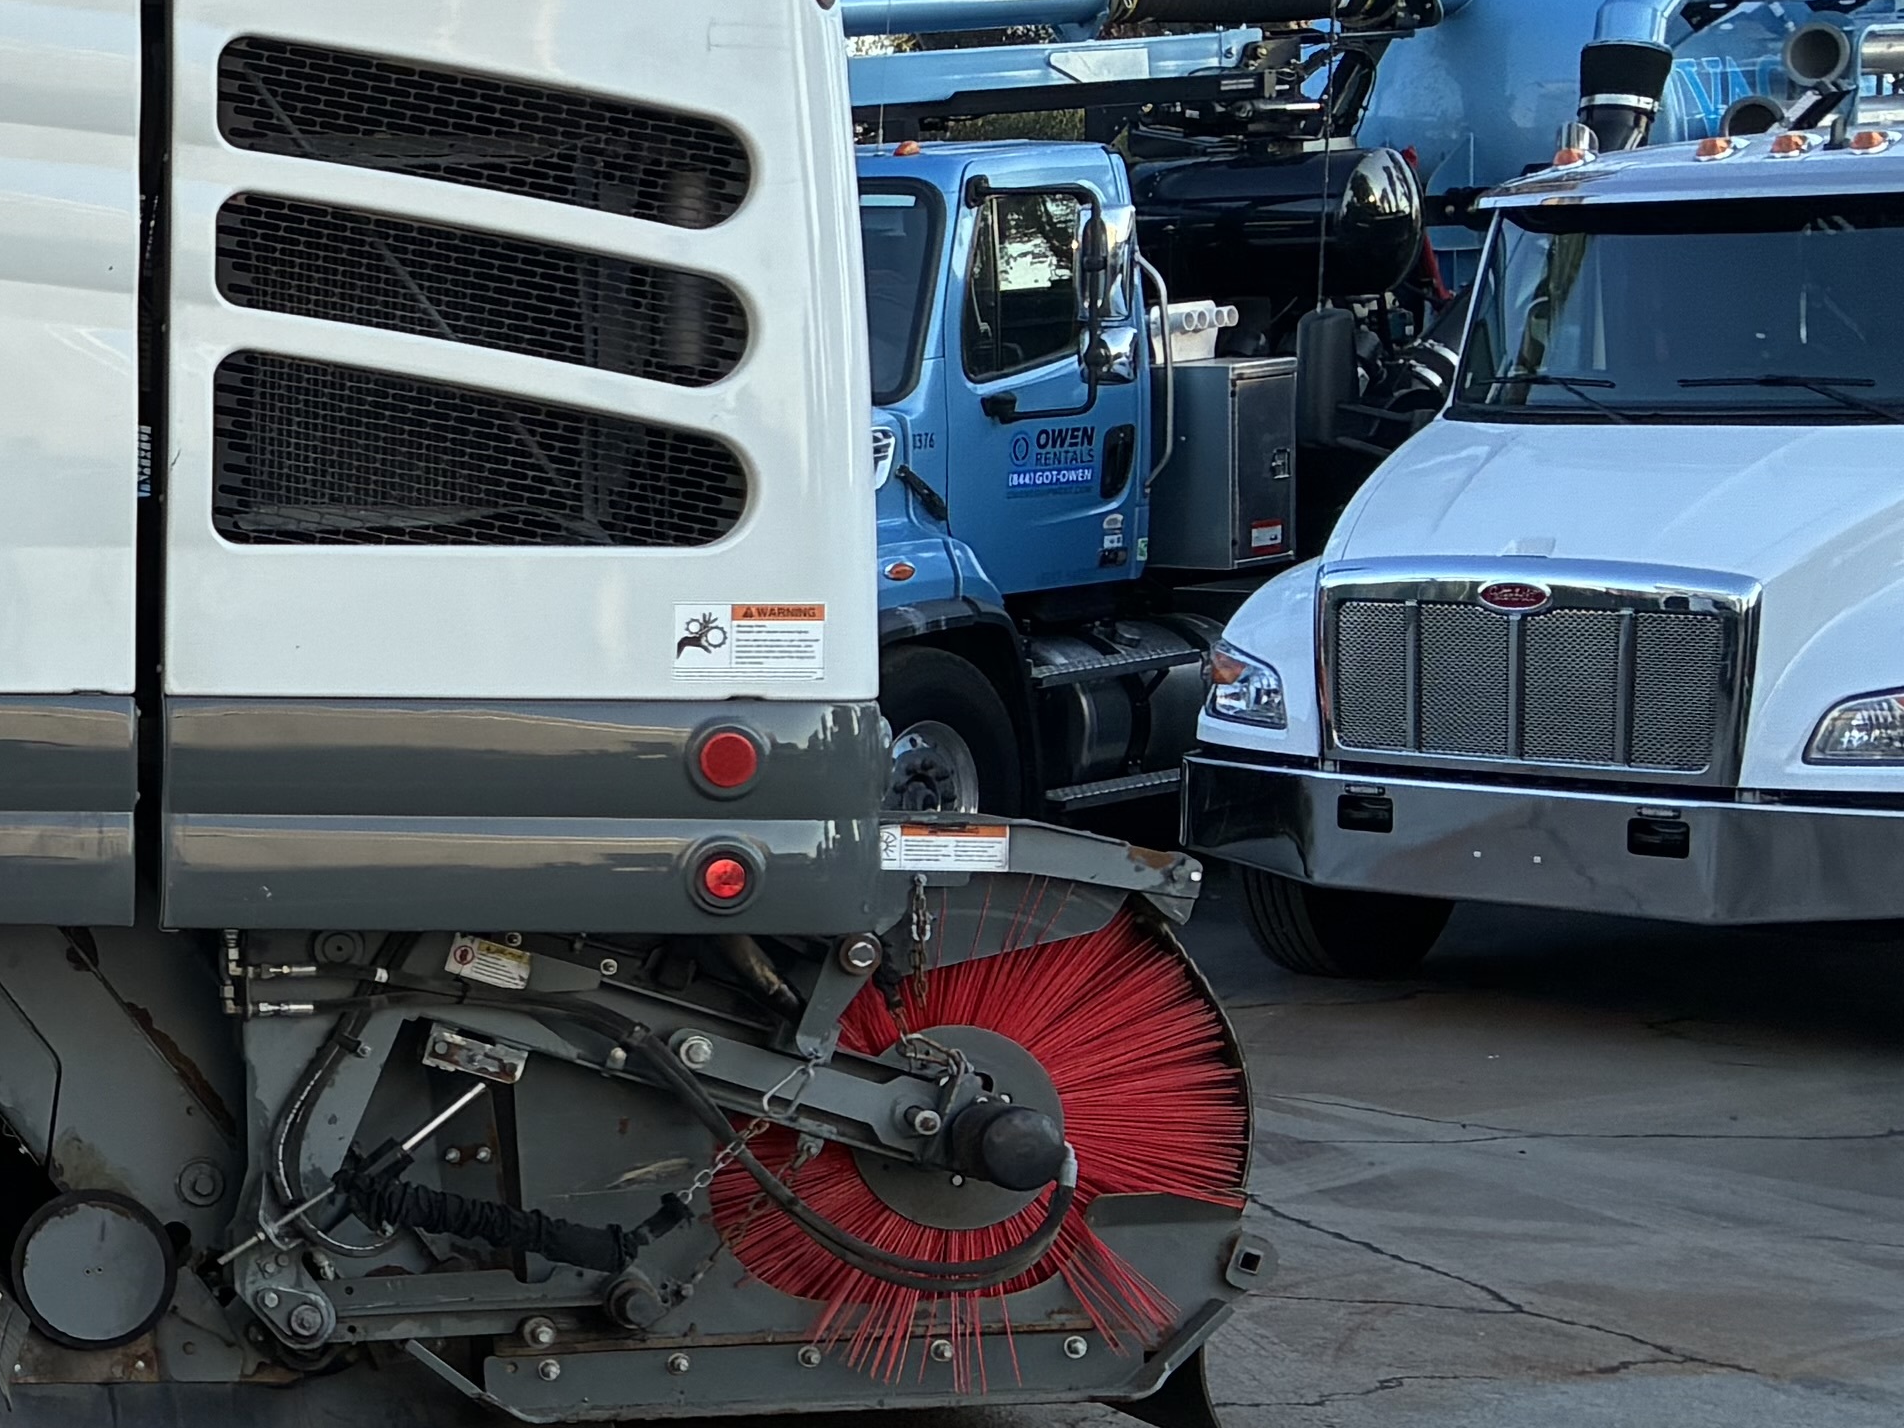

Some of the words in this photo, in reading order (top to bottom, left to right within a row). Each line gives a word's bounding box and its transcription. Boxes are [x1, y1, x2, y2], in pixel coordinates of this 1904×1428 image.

[1035, 425, 1095, 450] OWEN
[1034, 449, 1095, 467] RENTALS
[1008, 472, 1034, 487] (844)
[1035, 468, 1092, 485] GOT-OWEN
[755, 606, 817, 618] WARNING
